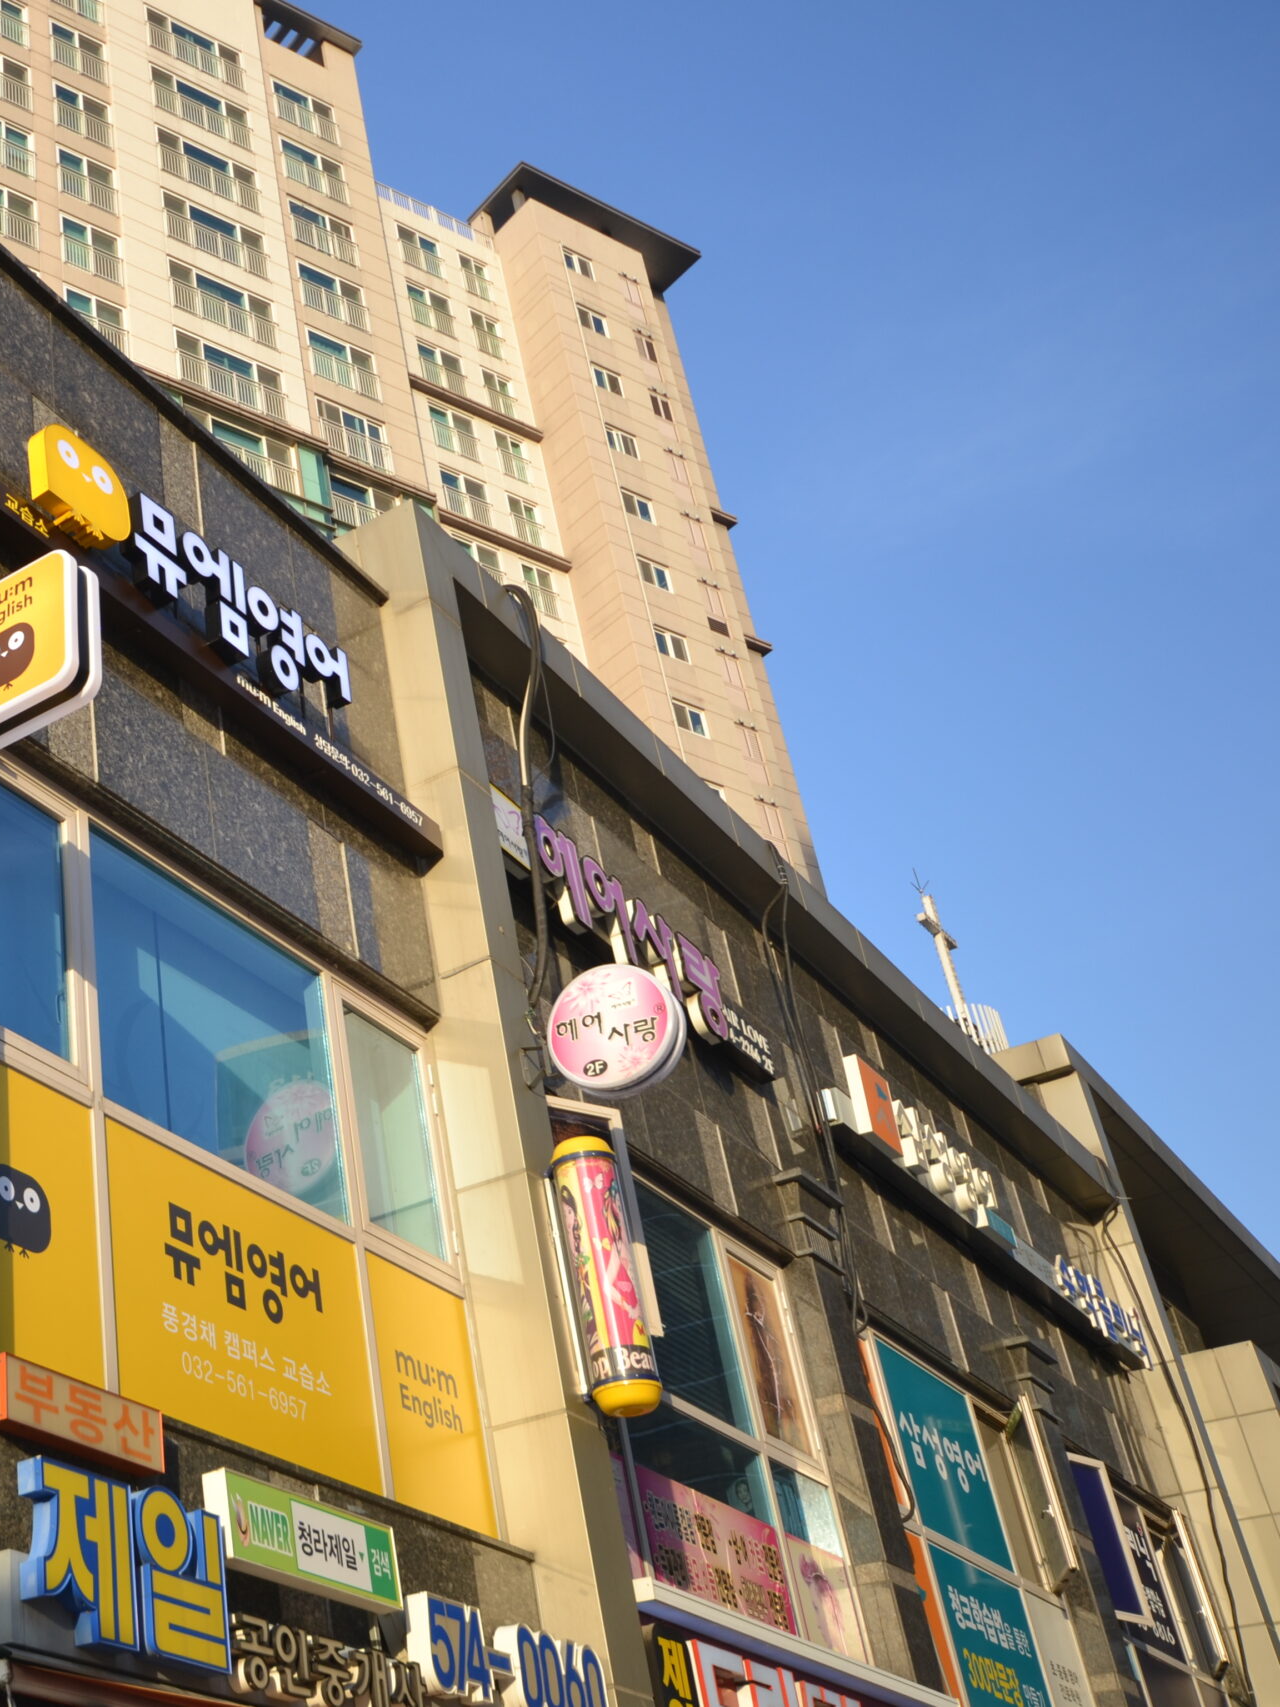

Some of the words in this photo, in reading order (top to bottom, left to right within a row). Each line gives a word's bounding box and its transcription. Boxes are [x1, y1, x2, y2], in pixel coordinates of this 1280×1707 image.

[4, 493, 50, 538] 교습소
[134, 493, 352, 703] 뮤엠영어
[273, 703, 307, 736] English
[586, 1061, 604, 1076] 2F
[741, 1019, 771, 1054] LOVE
[164, 1201, 323, 1325] 뮤엠영어
[162, 1302, 216, 1350] 풍경채
[224, 1330, 276, 1371] 캠퍼스
[282, 1356, 333, 1396] 교습소
[395, 1349, 458, 1398] mu:m
[15, 1364, 156, 1463] 부동산
[181, 1351, 308, 1421] 032-561-6957
[399, 1384, 463, 1433] English
[899, 1411, 987, 1494] 삼성영어
[248, 1501, 293, 1556] NAVER
[297, 1520, 358, 1571] 청라제일
[371, 1548, 392, 1580] 검색
[40, 1456, 232, 1674] 제일
[236, 1612, 429, 1707] 공인중개사
[426, 1594, 610, 1707] 574-0060
[657, 1636, 694, 1707] 제
